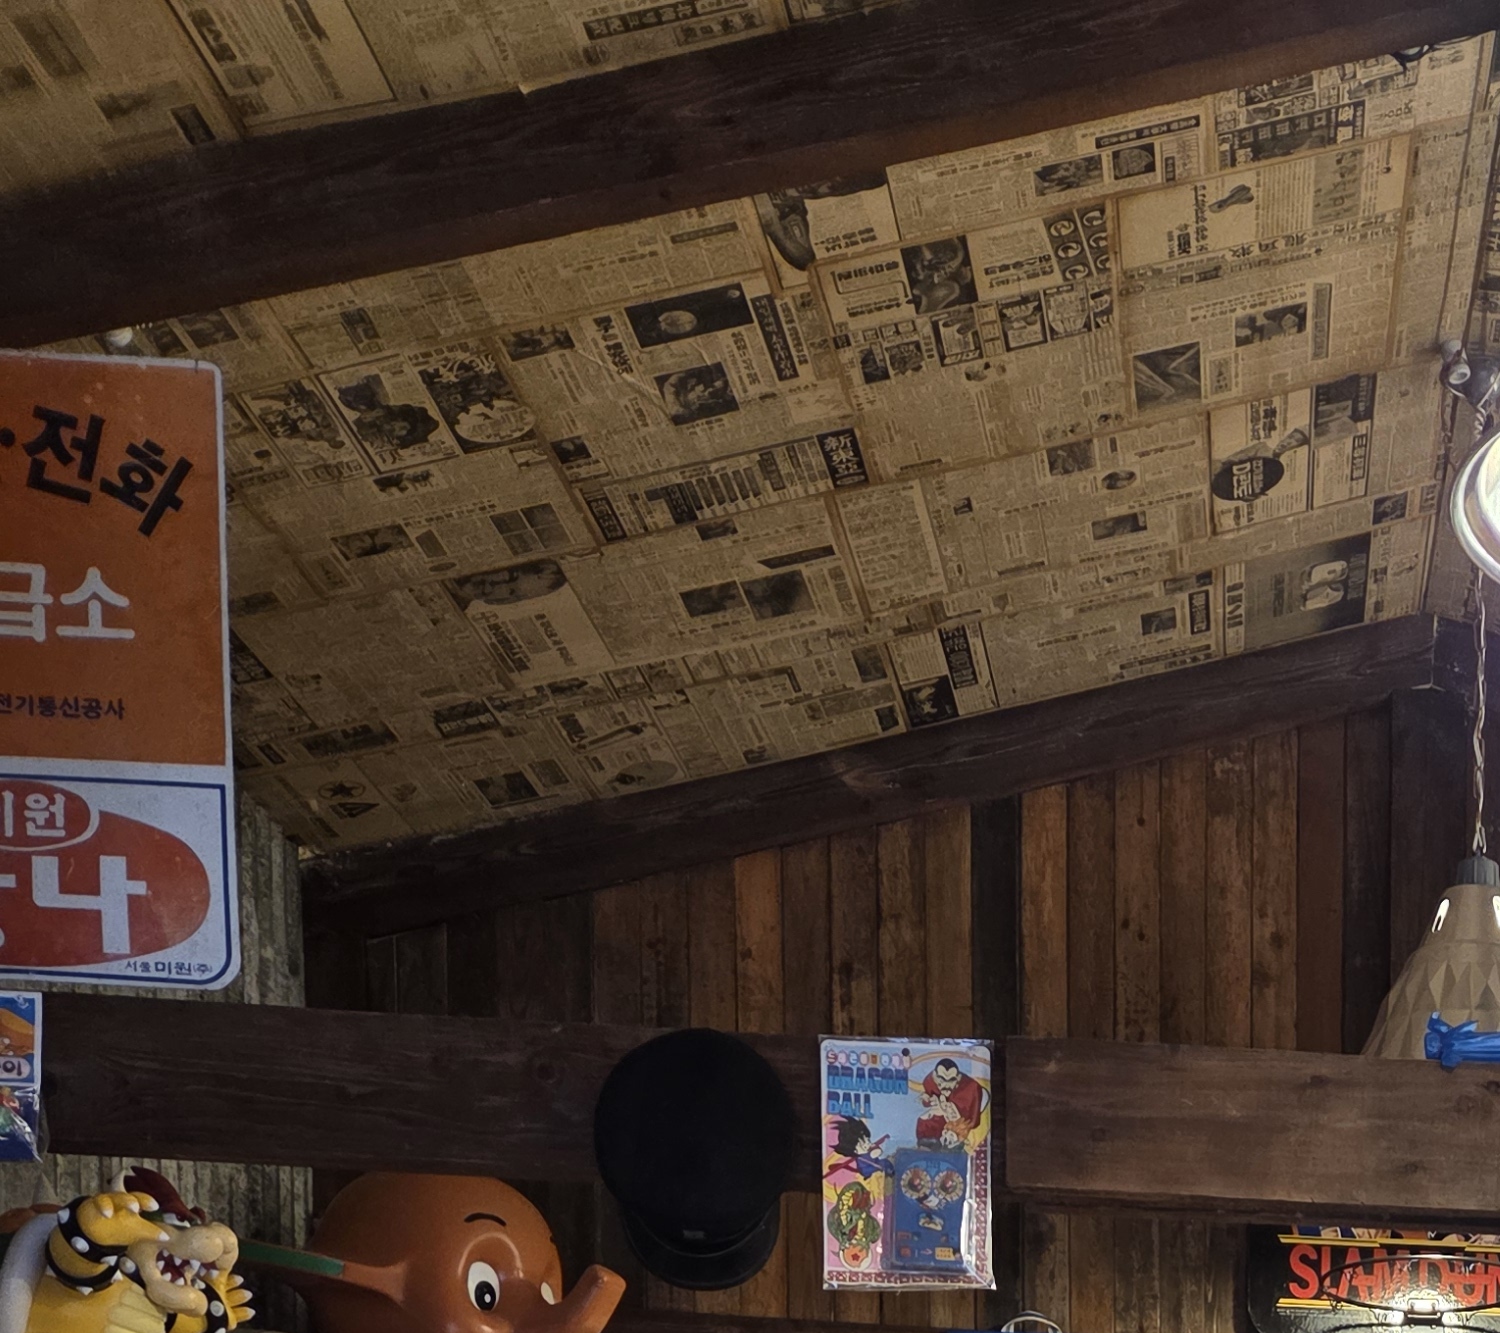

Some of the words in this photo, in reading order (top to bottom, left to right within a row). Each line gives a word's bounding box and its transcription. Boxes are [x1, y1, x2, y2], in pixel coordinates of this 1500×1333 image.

[3, 790, 67, 838] 원
[0, 854, 147, 954] 나
[827, 1065, 909, 1095] DRAGON
[827, 1091, 875, 1119] BALL
